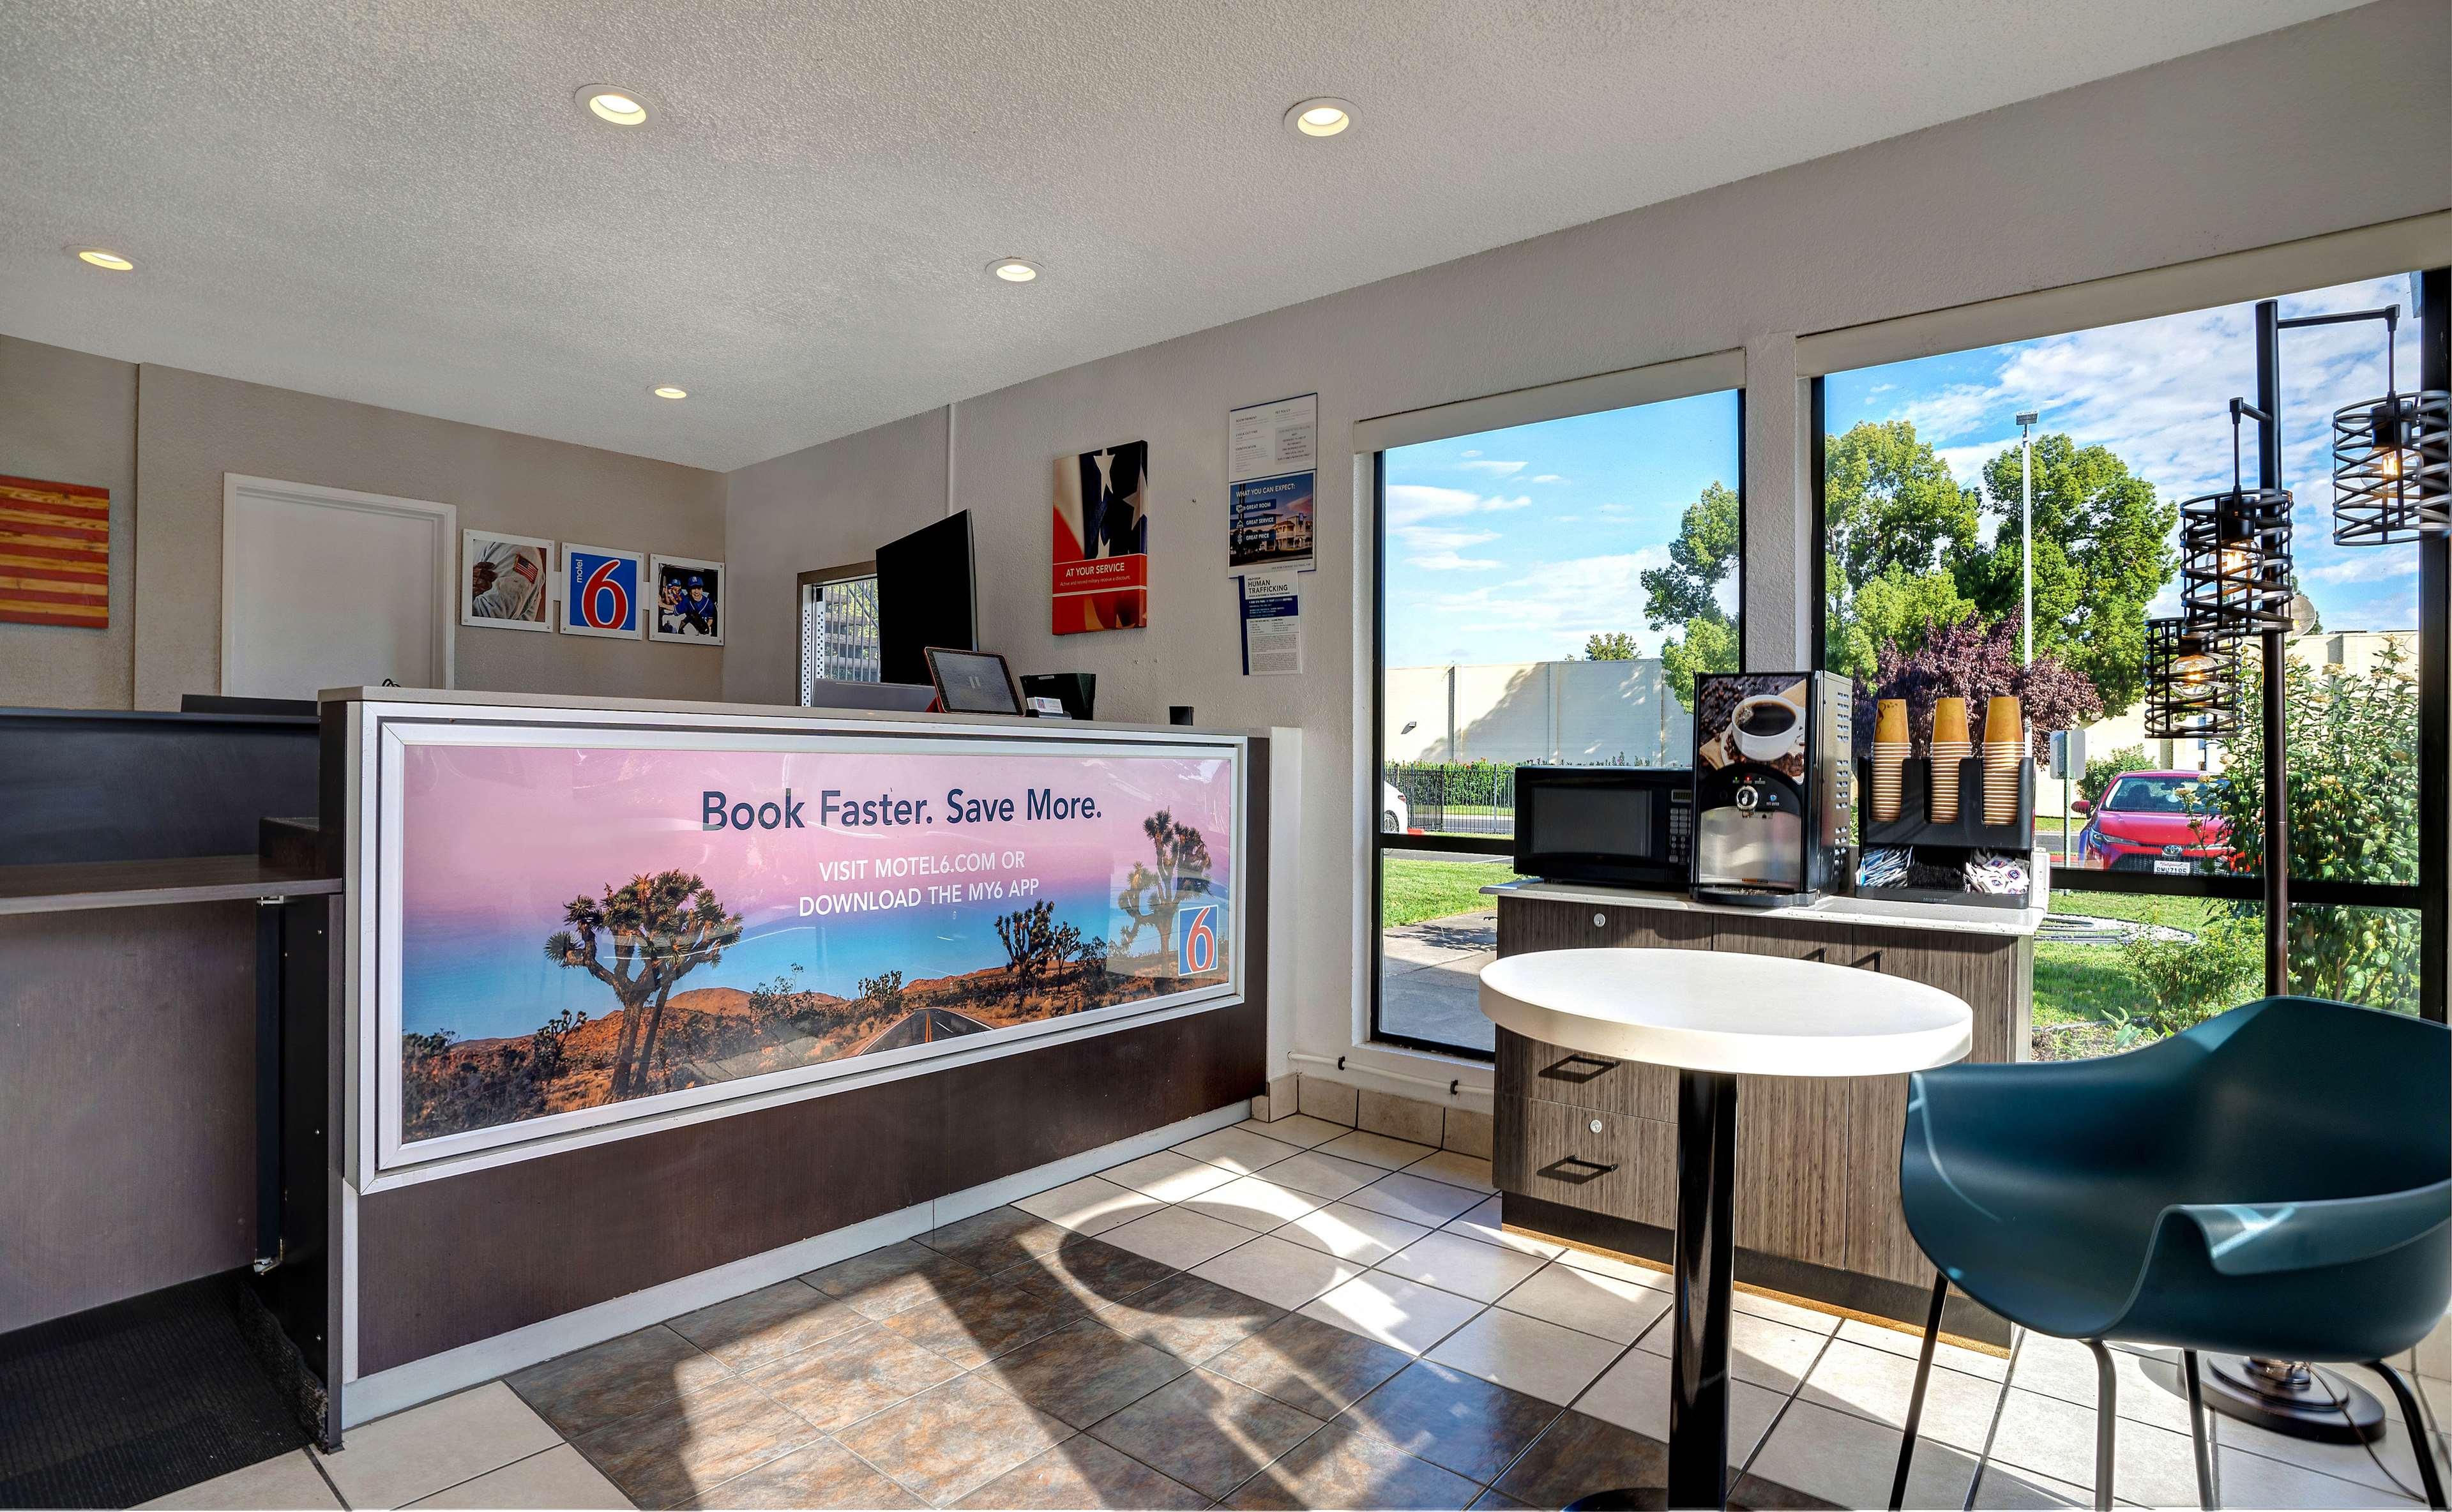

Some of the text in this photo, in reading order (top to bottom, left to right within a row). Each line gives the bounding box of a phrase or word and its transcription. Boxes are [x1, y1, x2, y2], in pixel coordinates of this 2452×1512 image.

[1066, 563, 1124, 577] AT YOUR SERVICE
[1248, 584, 1287, 593] TRAFFICKING
[582, 559, 629, 630] 6
[702, 788, 1102, 830] Book Faster. Save More.
[819, 850, 1025, 882] VISIT MOTEL6.COM OR
[799, 878, 1040, 918] DOWNLOAD THE MY6 APP
[1186, 907, 1215, 974] 6
